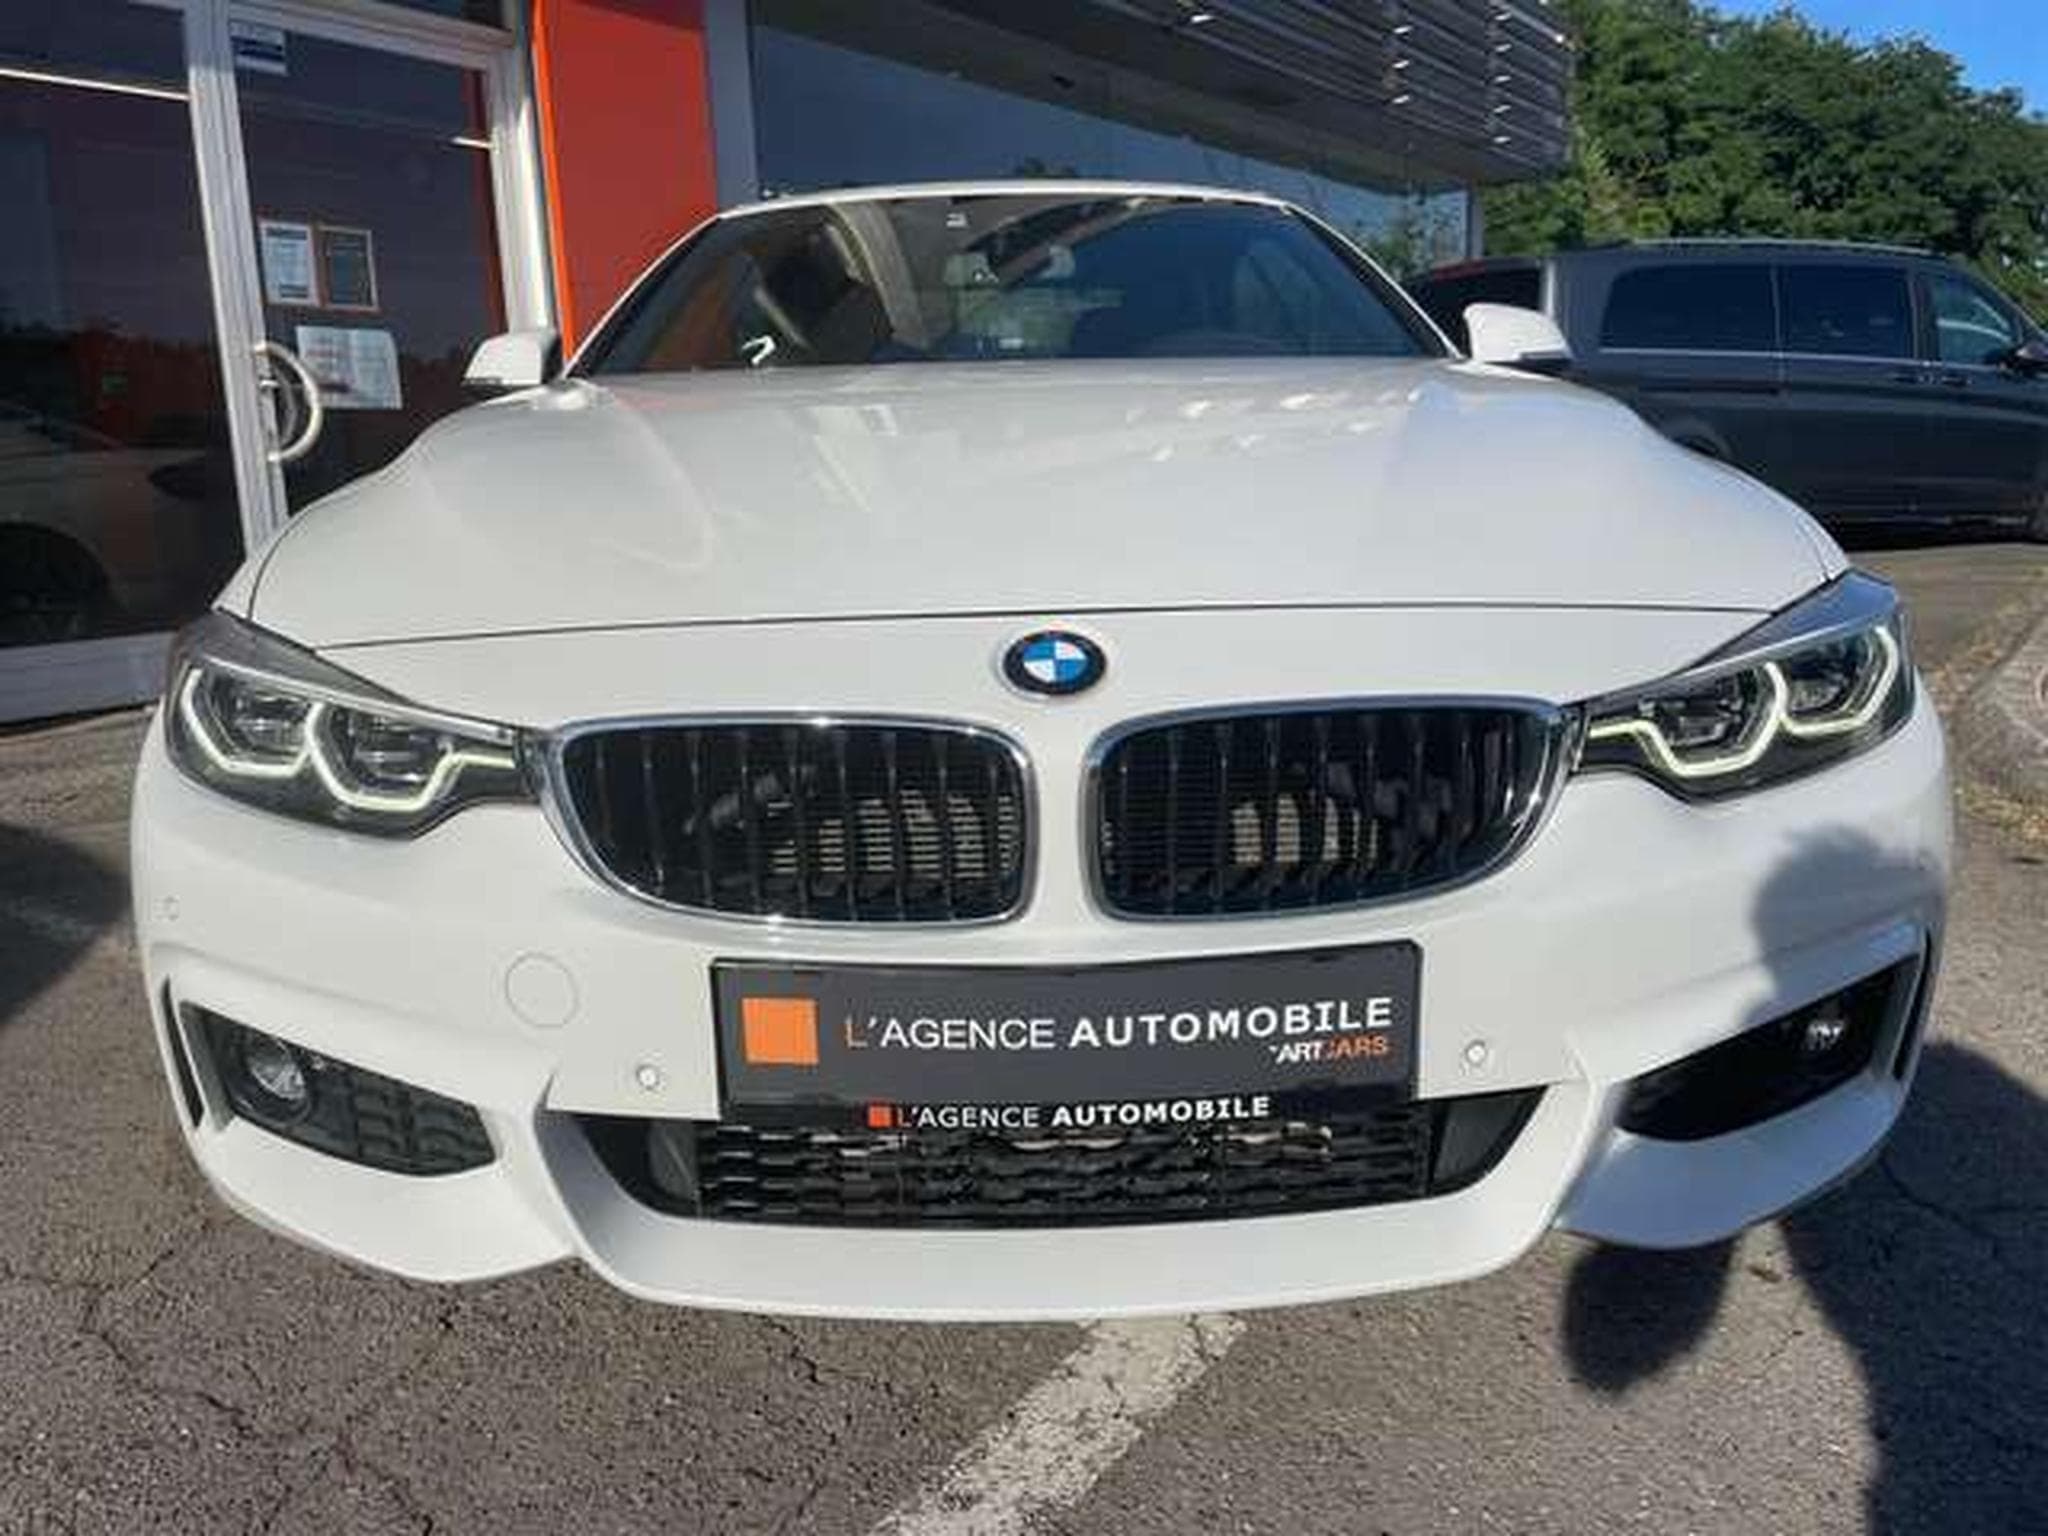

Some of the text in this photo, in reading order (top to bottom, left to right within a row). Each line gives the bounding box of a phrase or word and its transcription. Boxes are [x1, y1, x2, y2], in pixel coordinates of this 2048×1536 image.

[845, 997, 1393, 1049] L'AGENCE AUTOMOBILE
[899, 1096, 1271, 1128] L'AGENCE AUTOMOBILE
